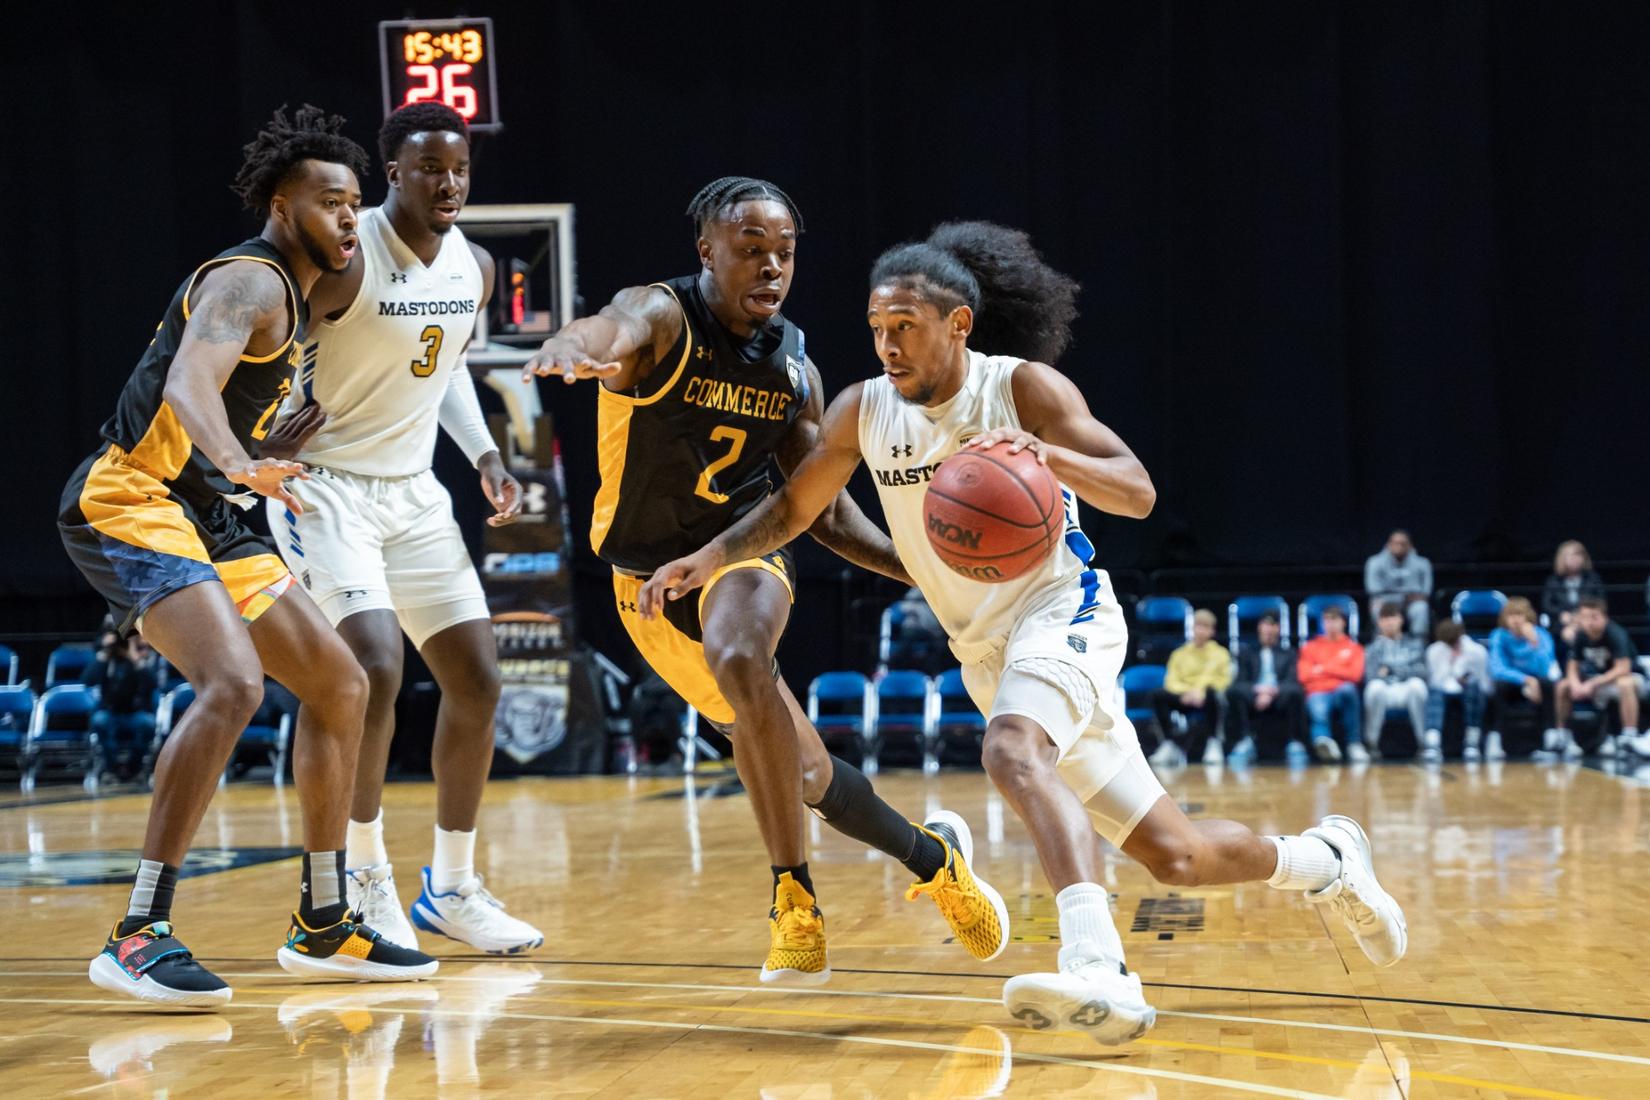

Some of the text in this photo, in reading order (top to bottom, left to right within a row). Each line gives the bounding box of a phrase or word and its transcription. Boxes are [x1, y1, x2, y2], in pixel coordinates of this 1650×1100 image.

[404, 29, 483, 64] 15:43
[406, 63, 477, 119] 26
[378, 299, 475, 316] MASTODONS
[410, 323, 444, 378] 3
[683, 376, 793, 421] COMMERCE
[694, 425, 747, 504] 2
[928, 511, 984, 551] NCAA
